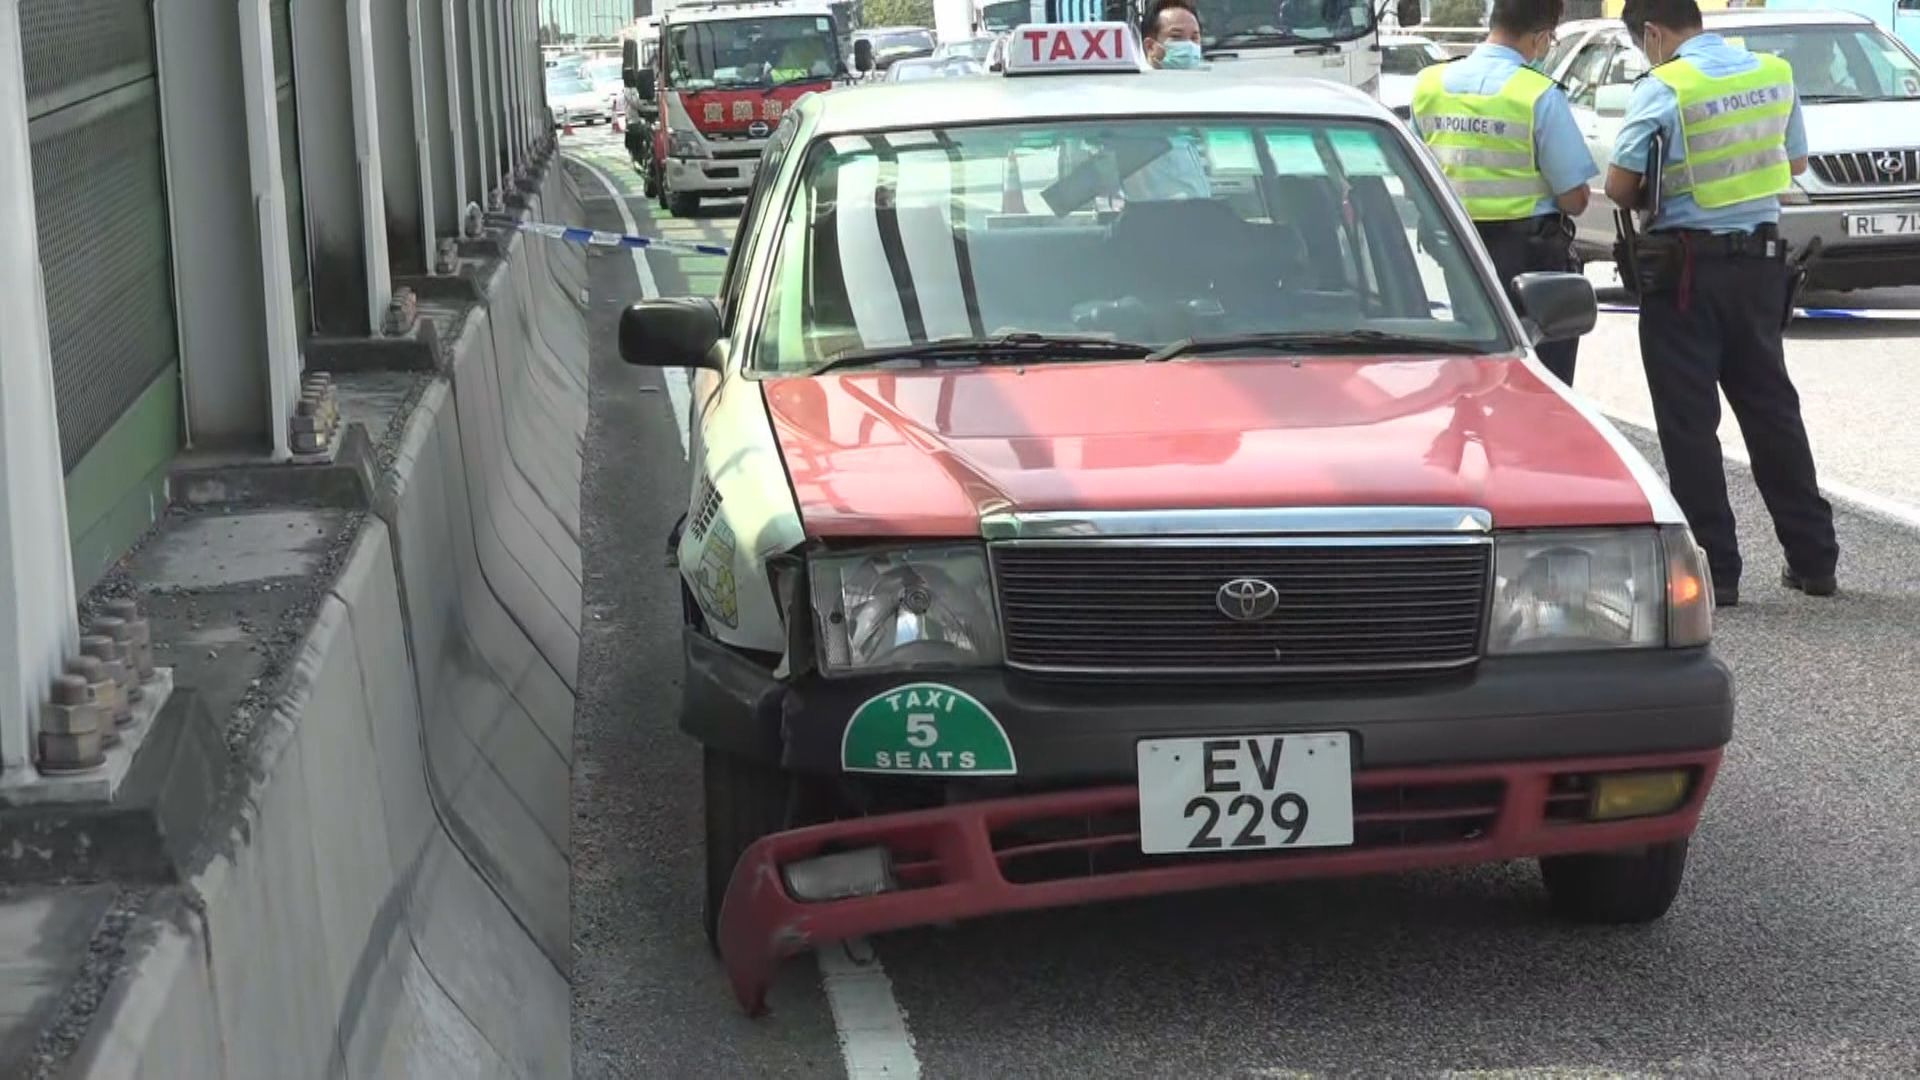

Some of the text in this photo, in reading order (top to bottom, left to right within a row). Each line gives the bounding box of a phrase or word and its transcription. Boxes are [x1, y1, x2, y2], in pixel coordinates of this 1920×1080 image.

[1023, 29, 1123, 62] TAXI
[1722, 89, 1766, 111] POLICE
[1446, 117, 1488, 133] POLICE
[1857, 216, 1884, 234] RL
[886, 691, 956, 713] TAXI
[906, 713, 938, 748] 5
[875, 751, 977, 769] SEATS
[1202, 738, 1284, 793] EV
[1183, 792, 1309, 849] 229
